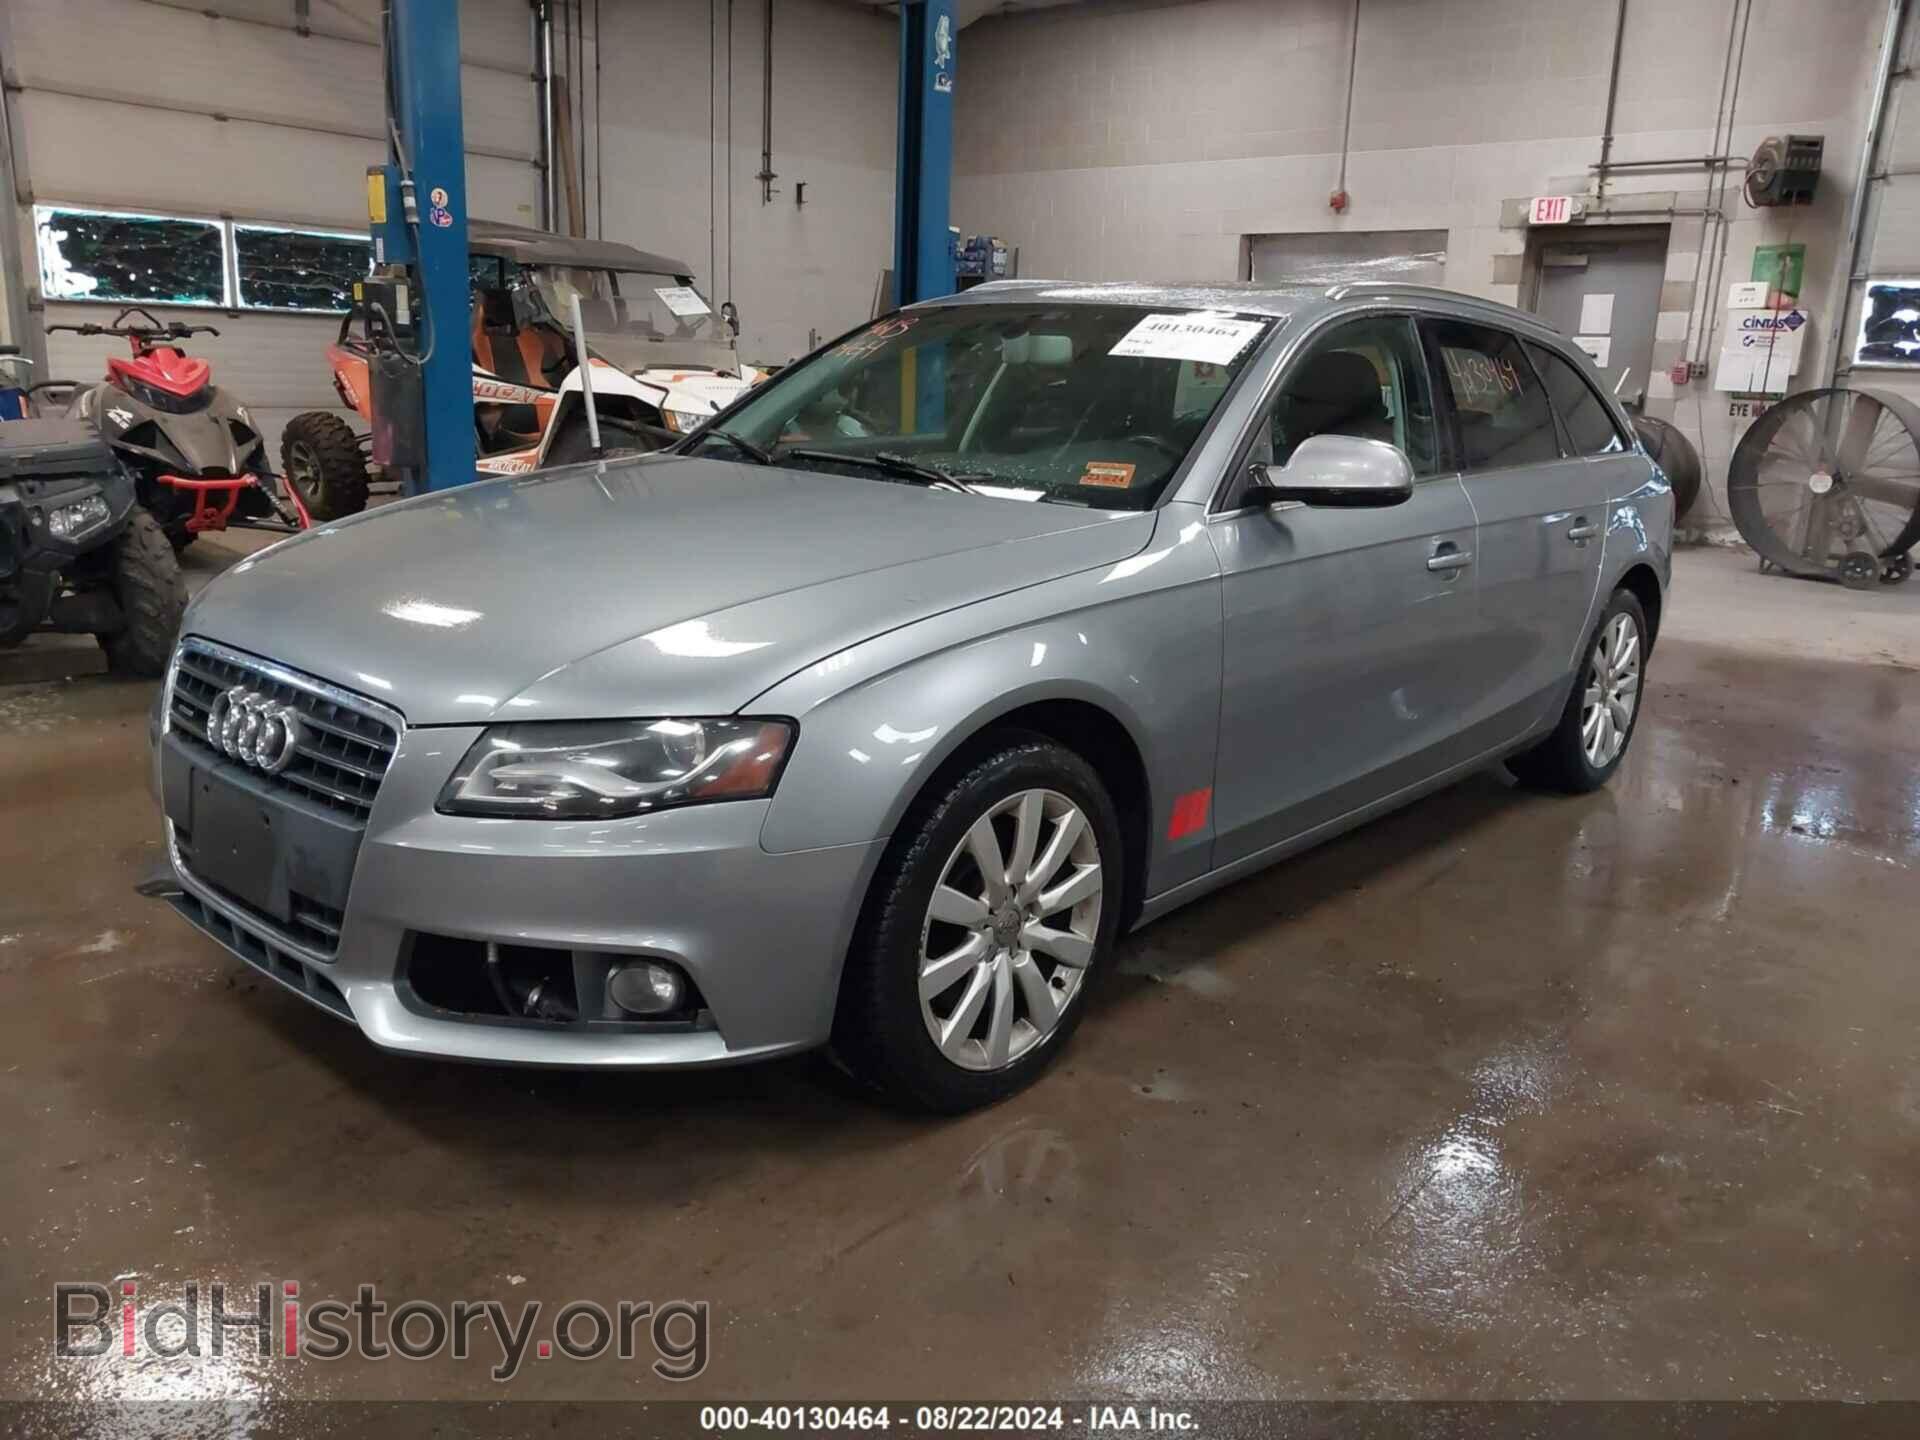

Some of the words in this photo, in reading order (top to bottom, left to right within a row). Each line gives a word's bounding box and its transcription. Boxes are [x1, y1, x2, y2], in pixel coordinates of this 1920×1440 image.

[1536, 198, 1567, 221] EXIT
[1147, 321, 1240, 338] 40130464
[1729, 403, 1748, 417] EYE
